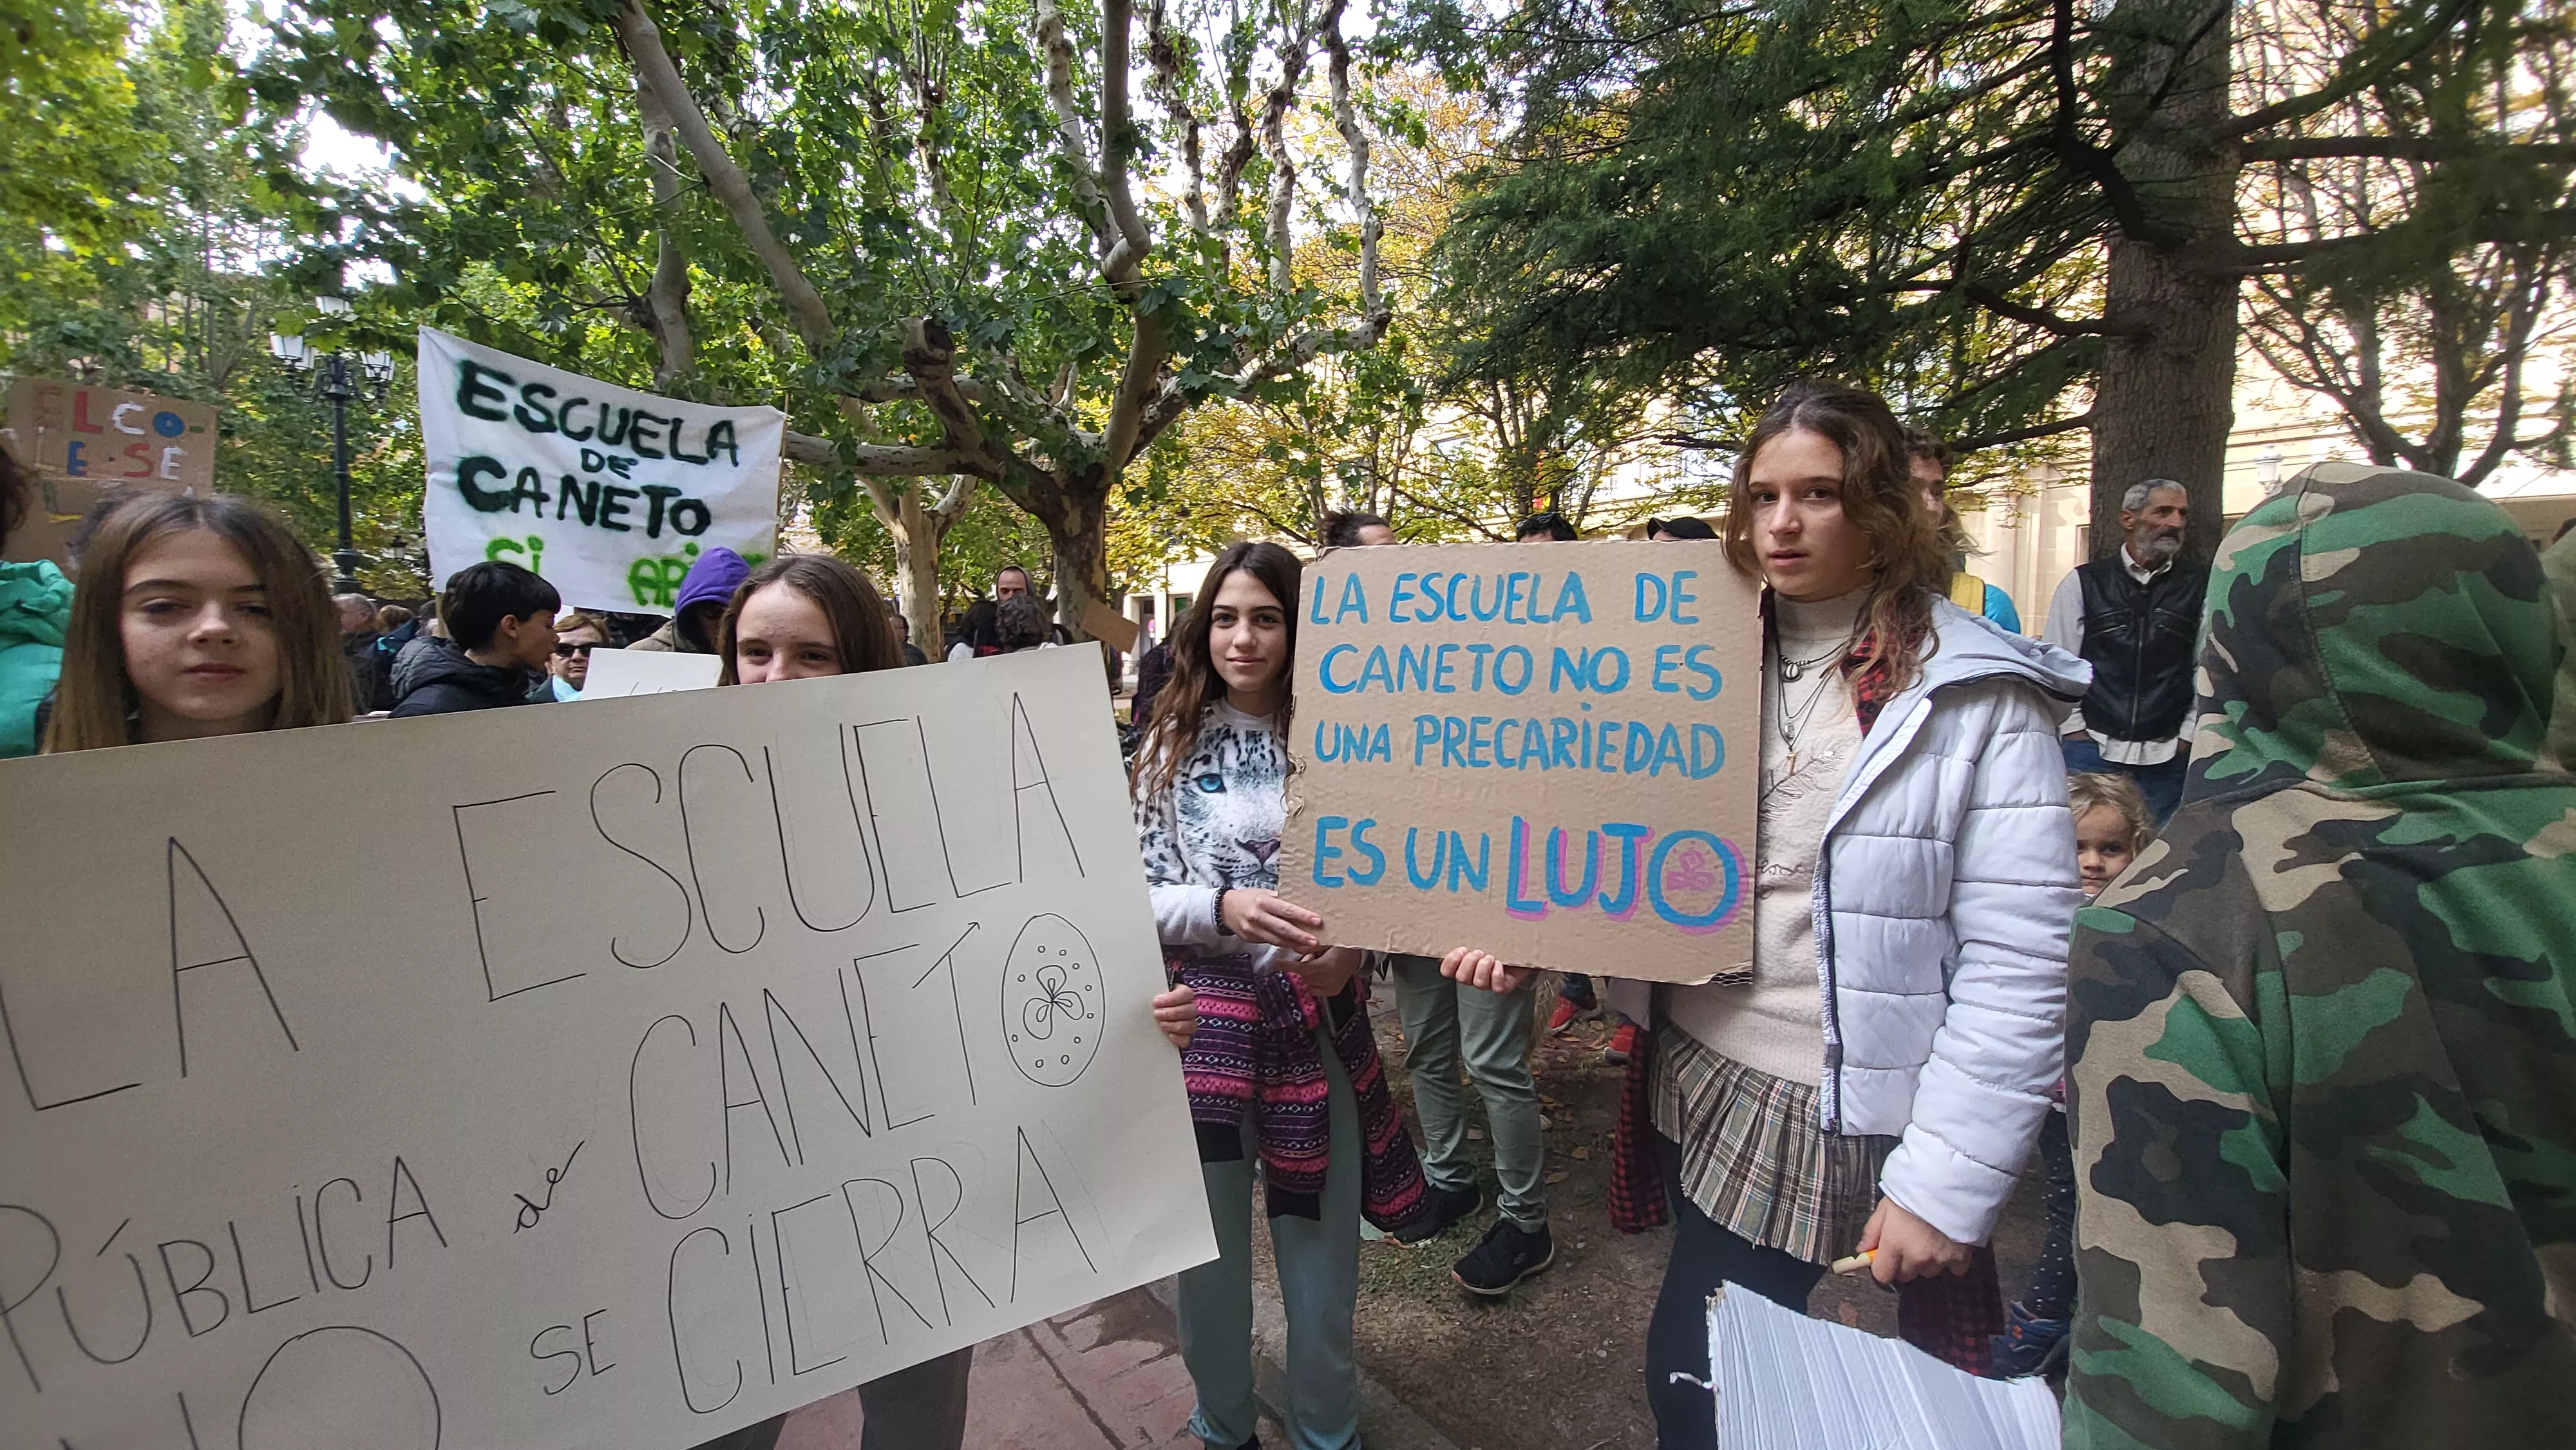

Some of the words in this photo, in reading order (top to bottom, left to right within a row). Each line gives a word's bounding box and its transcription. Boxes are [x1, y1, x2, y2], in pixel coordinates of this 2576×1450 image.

[456, 359, 739, 467] ESCUELA
[122, 442, 187, 481] SE
[457, 455, 712, 538] CANETO
[581, 447, 638, 480] DE
[1309, 571, 1368, 625] LA
[1389, 570, 1593, 625] ESCUELA
[1634, 570, 1699, 625] DE
[1319, 643, 1534, 695] CANETO
[1549, 645, 1631, 695] NO
[1651, 644, 1723, 702] ES
[1314, 719, 1392, 764] UNA
[453, 692, 1084, 1002] ESCUELA
[1311, 814, 1387, 889] ES
[1404, 825, 1490, 893] UN
[1504, 814, 1750, 936] LUJO
[514, 1140, 585, 1234] de
[630, 912, 1106, 1219] CANETO
[530, 1308, 616, 1395] SE
